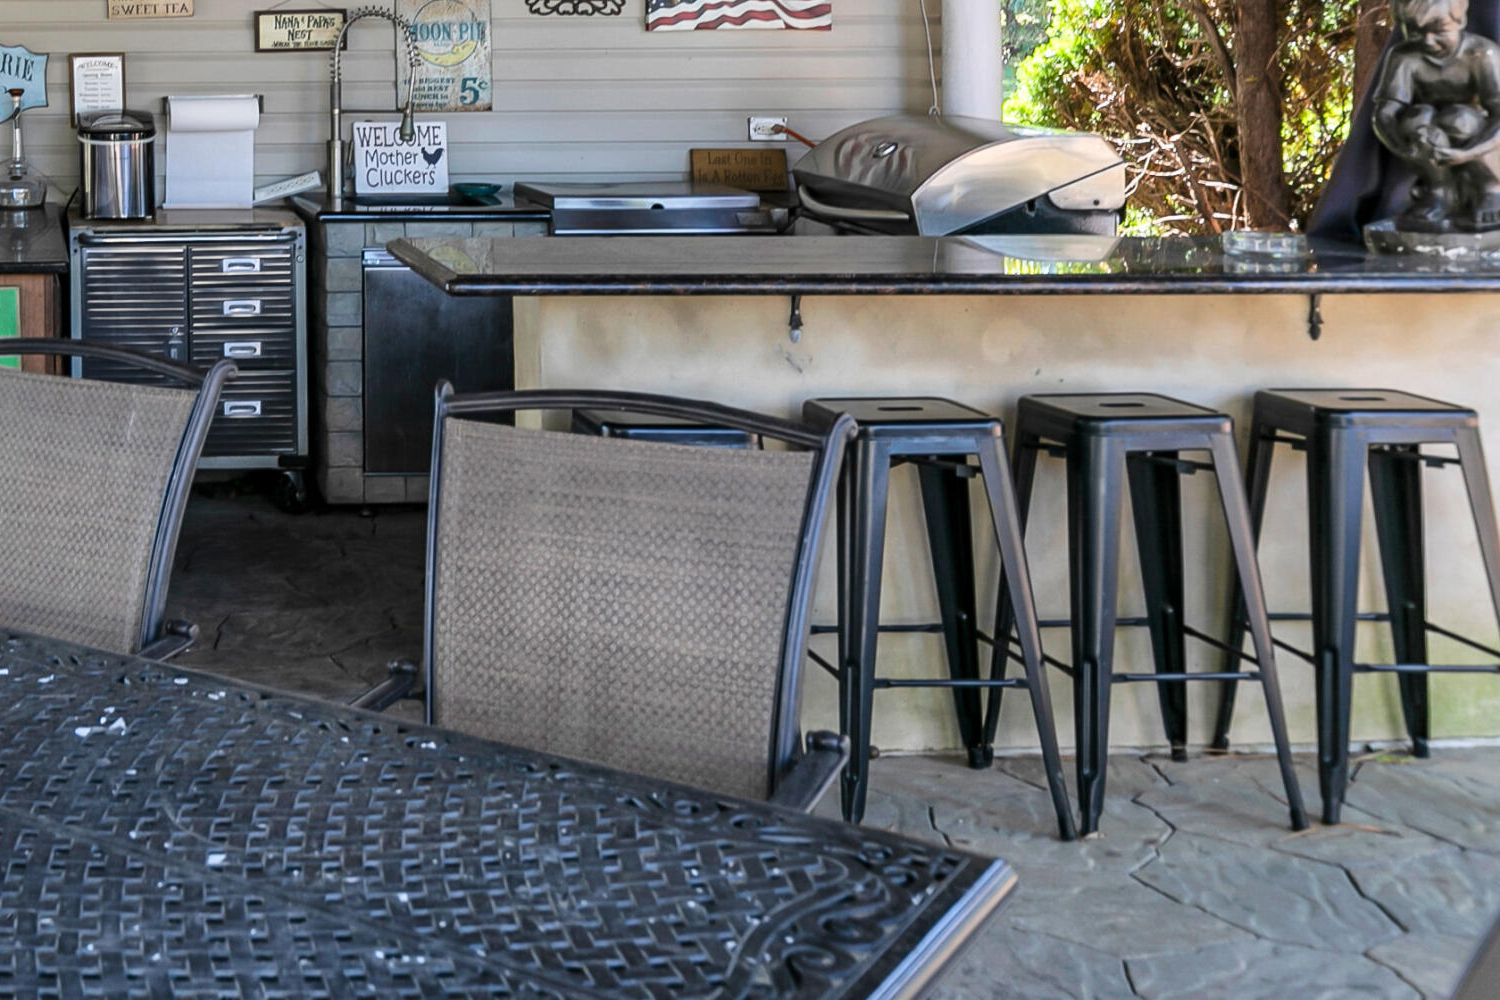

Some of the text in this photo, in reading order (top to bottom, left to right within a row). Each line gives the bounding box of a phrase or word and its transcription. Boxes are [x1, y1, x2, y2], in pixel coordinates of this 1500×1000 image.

[112, 3, 188, 15] SWEET TEA
[275, 14, 299, 29] NANA
[459, 21, 486, 40] PIE
[357, 125, 442, 148] WELCOME
[365, 149, 418, 168] Mother
[735, 152, 757, 165] One
[366, 168, 436, 188] Cluckers
